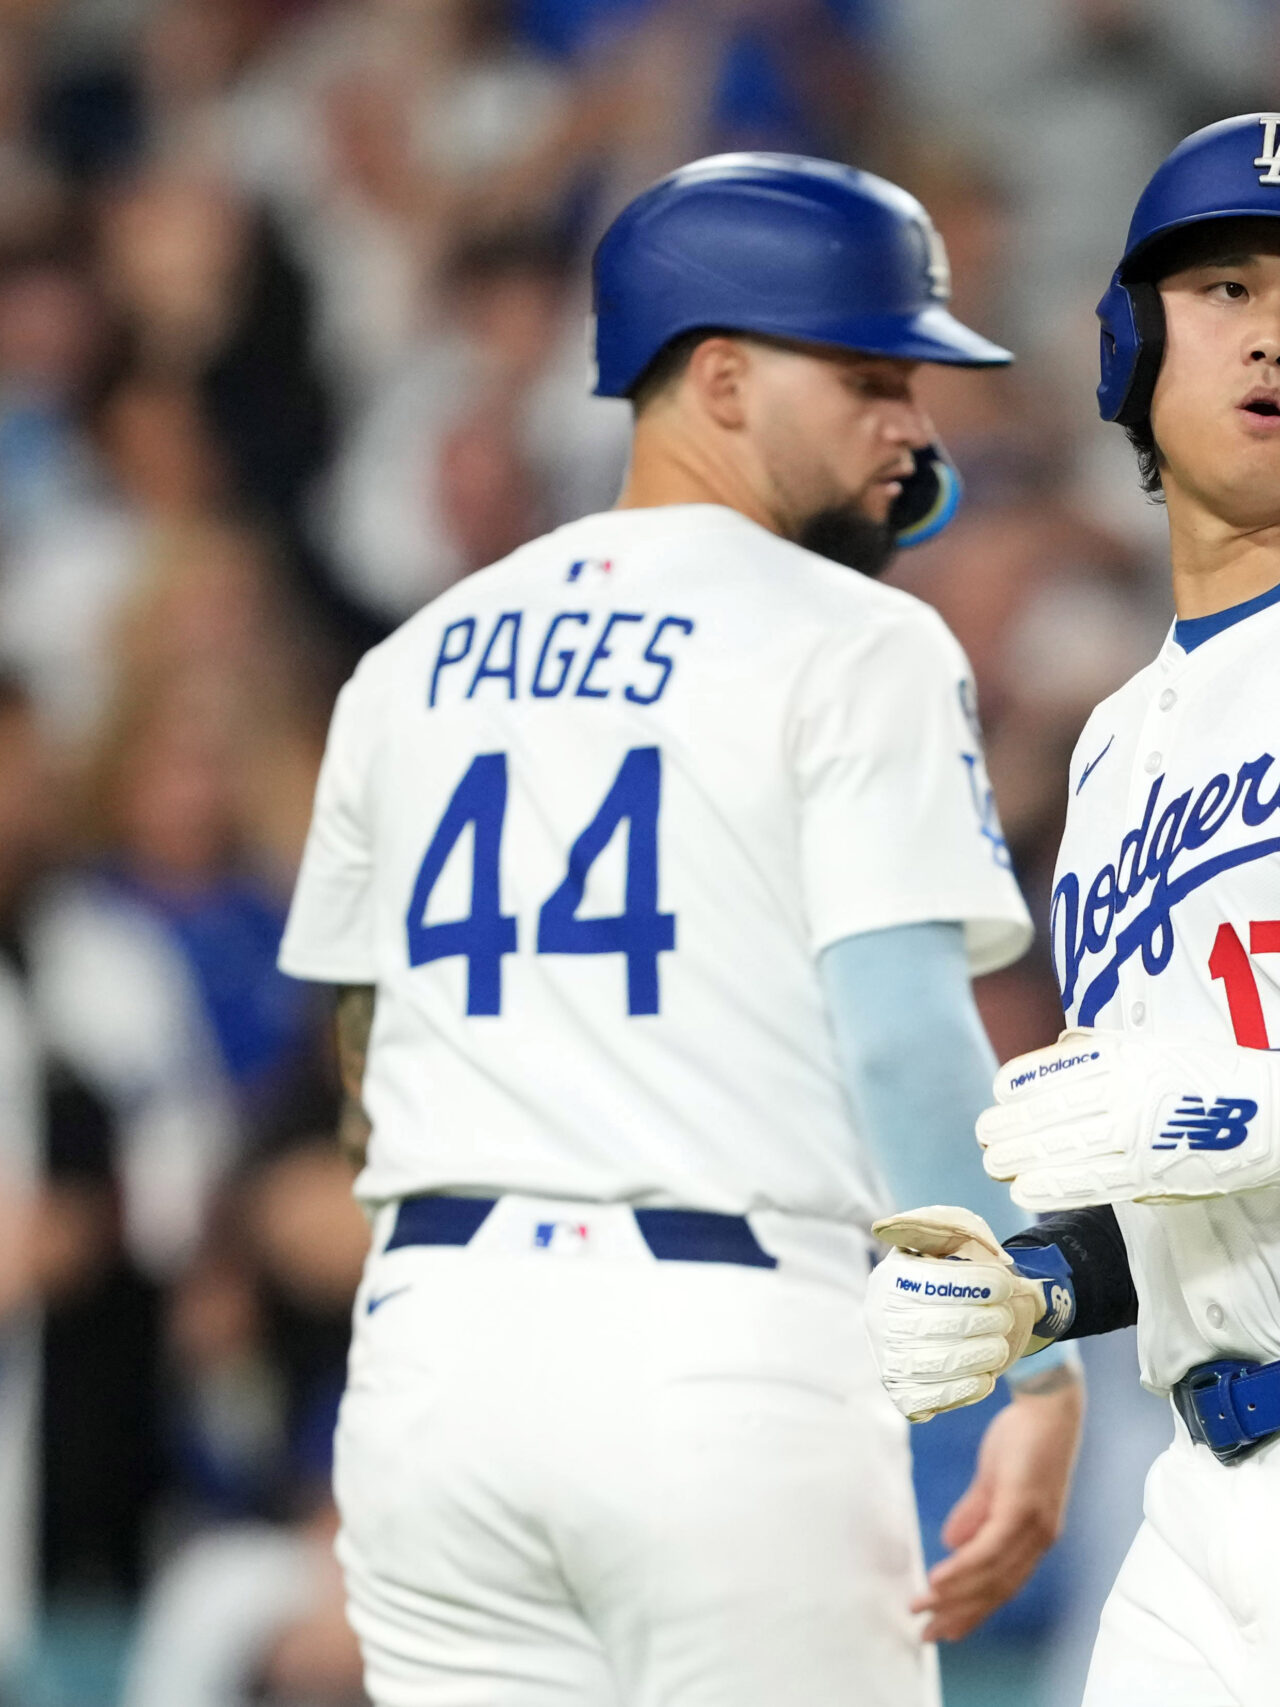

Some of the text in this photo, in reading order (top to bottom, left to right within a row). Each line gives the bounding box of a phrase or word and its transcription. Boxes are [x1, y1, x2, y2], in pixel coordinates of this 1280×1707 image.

[427, 610, 695, 709] PAGES
[405, 745, 677, 1017] 44
[1009, 1050, 1101, 1091] new balance
[895, 1276, 992, 1300] new balance
